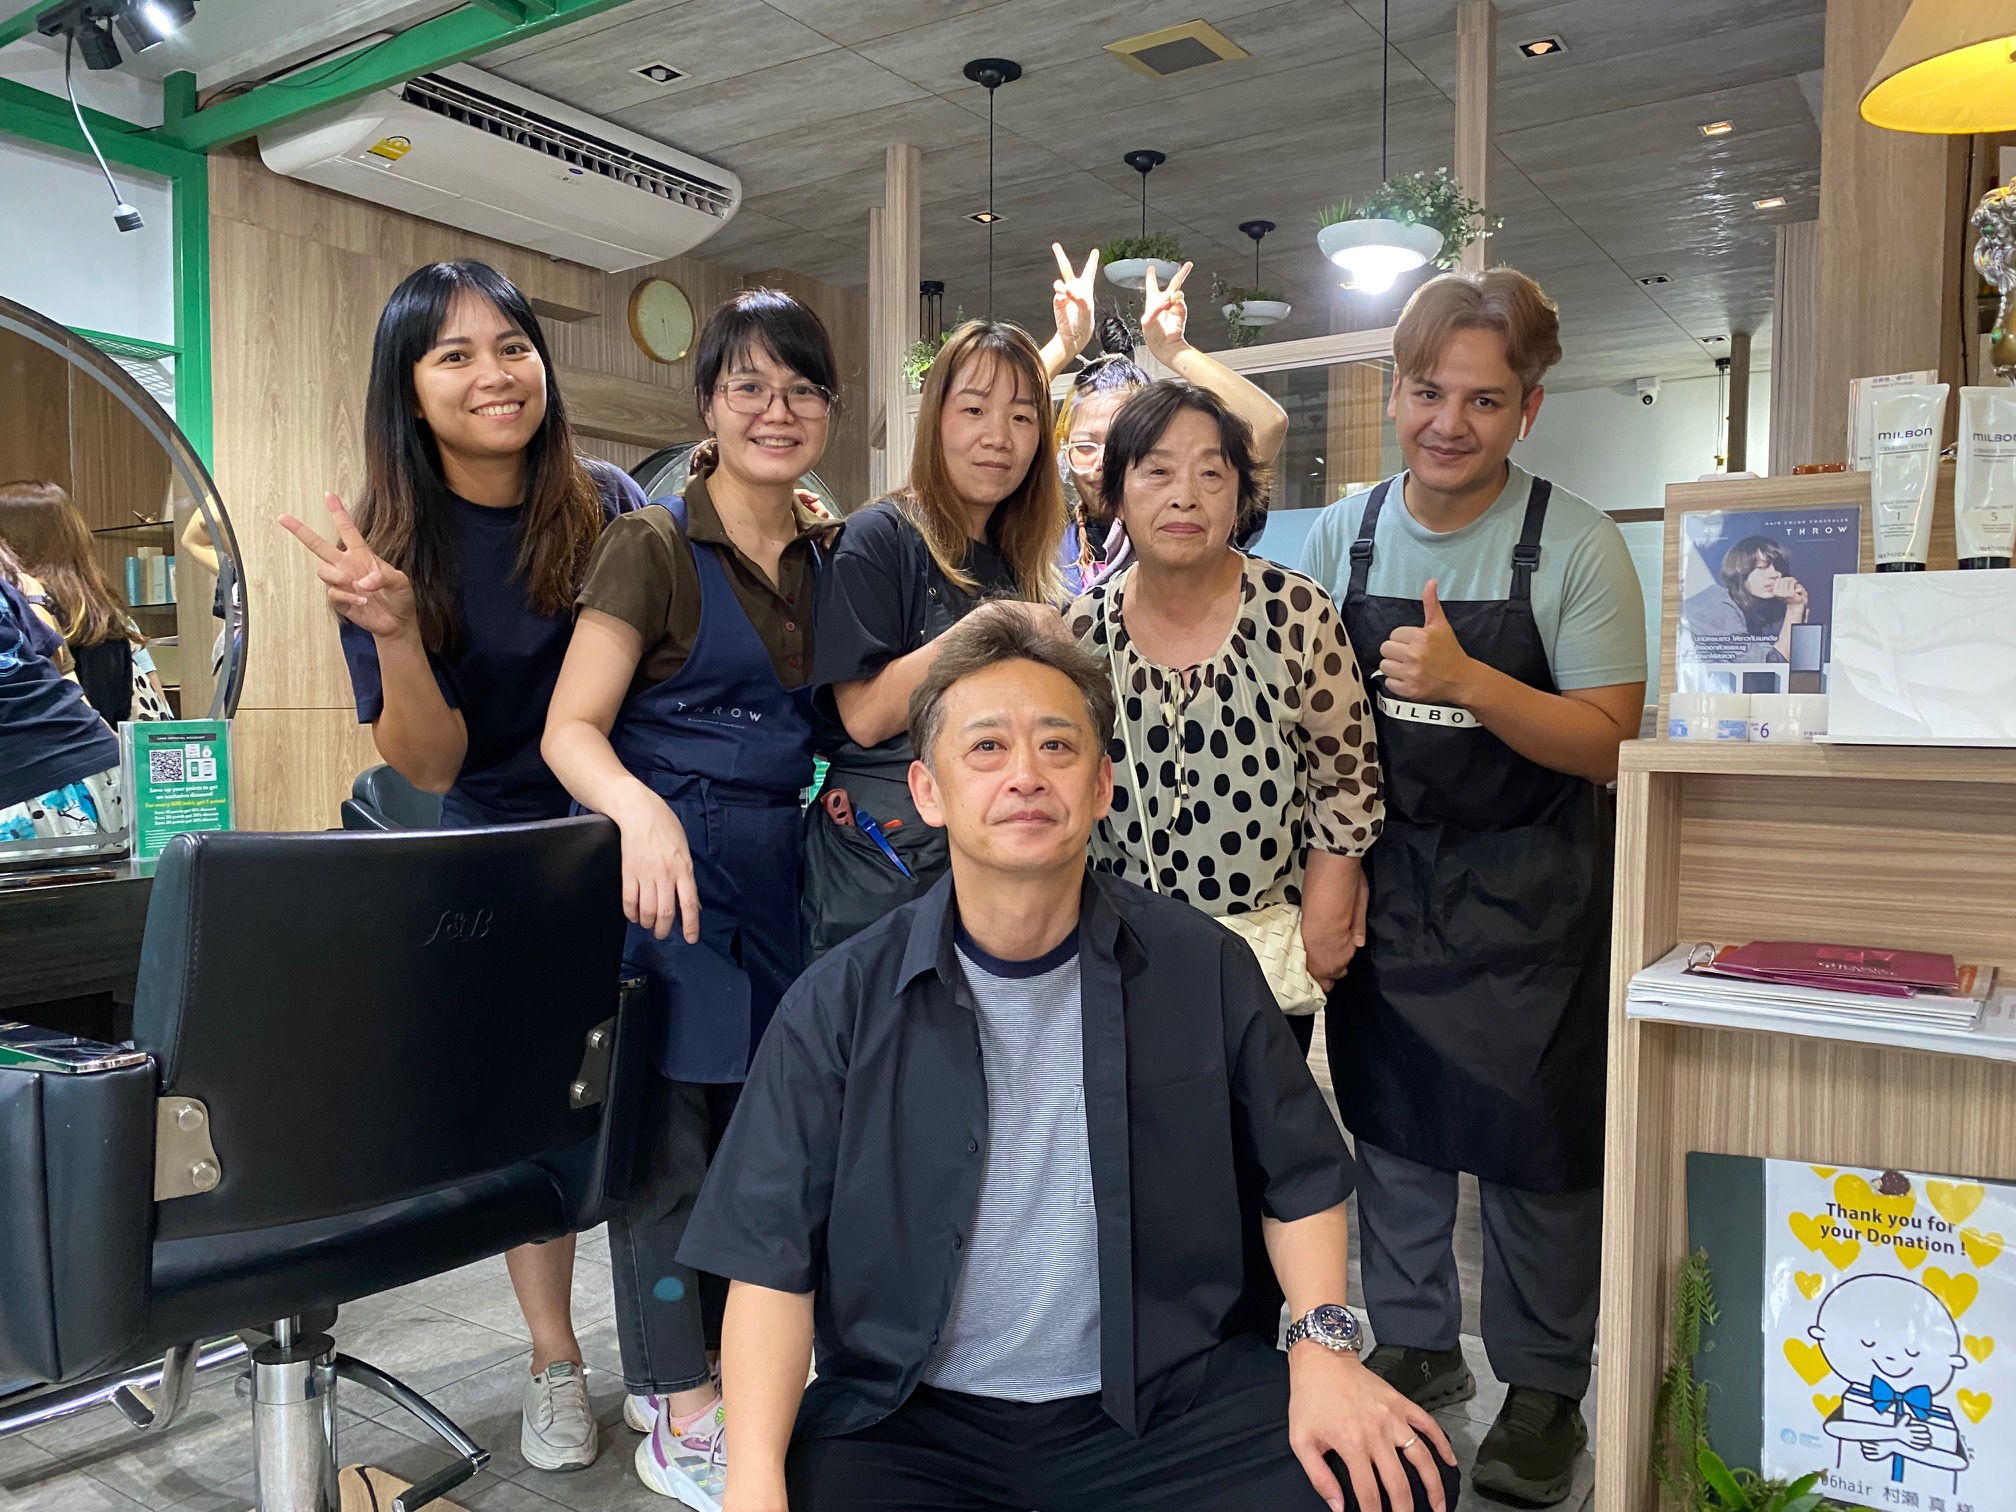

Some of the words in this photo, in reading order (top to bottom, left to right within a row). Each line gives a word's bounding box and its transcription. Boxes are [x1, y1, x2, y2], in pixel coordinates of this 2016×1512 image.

[1808, 517, 1849, 525] CONCEALER
[1785, 526, 1848, 537] THROW
[678, 702, 762, 722] THROW
[1760, 722, 1770, 739] 6
[185, 784, 203, 793] points
[208, 784, 219, 792] get
[164, 792, 190, 800] exclusive
[1825, 1201, 1884, 1224] Thank
[1887, 1213, 1923, 1230] you
[1927, 1216, 1957, 1234] for
[1819, 1224, 1863, 1242] your
[1866, 1227, 1956, 1256] Donation
